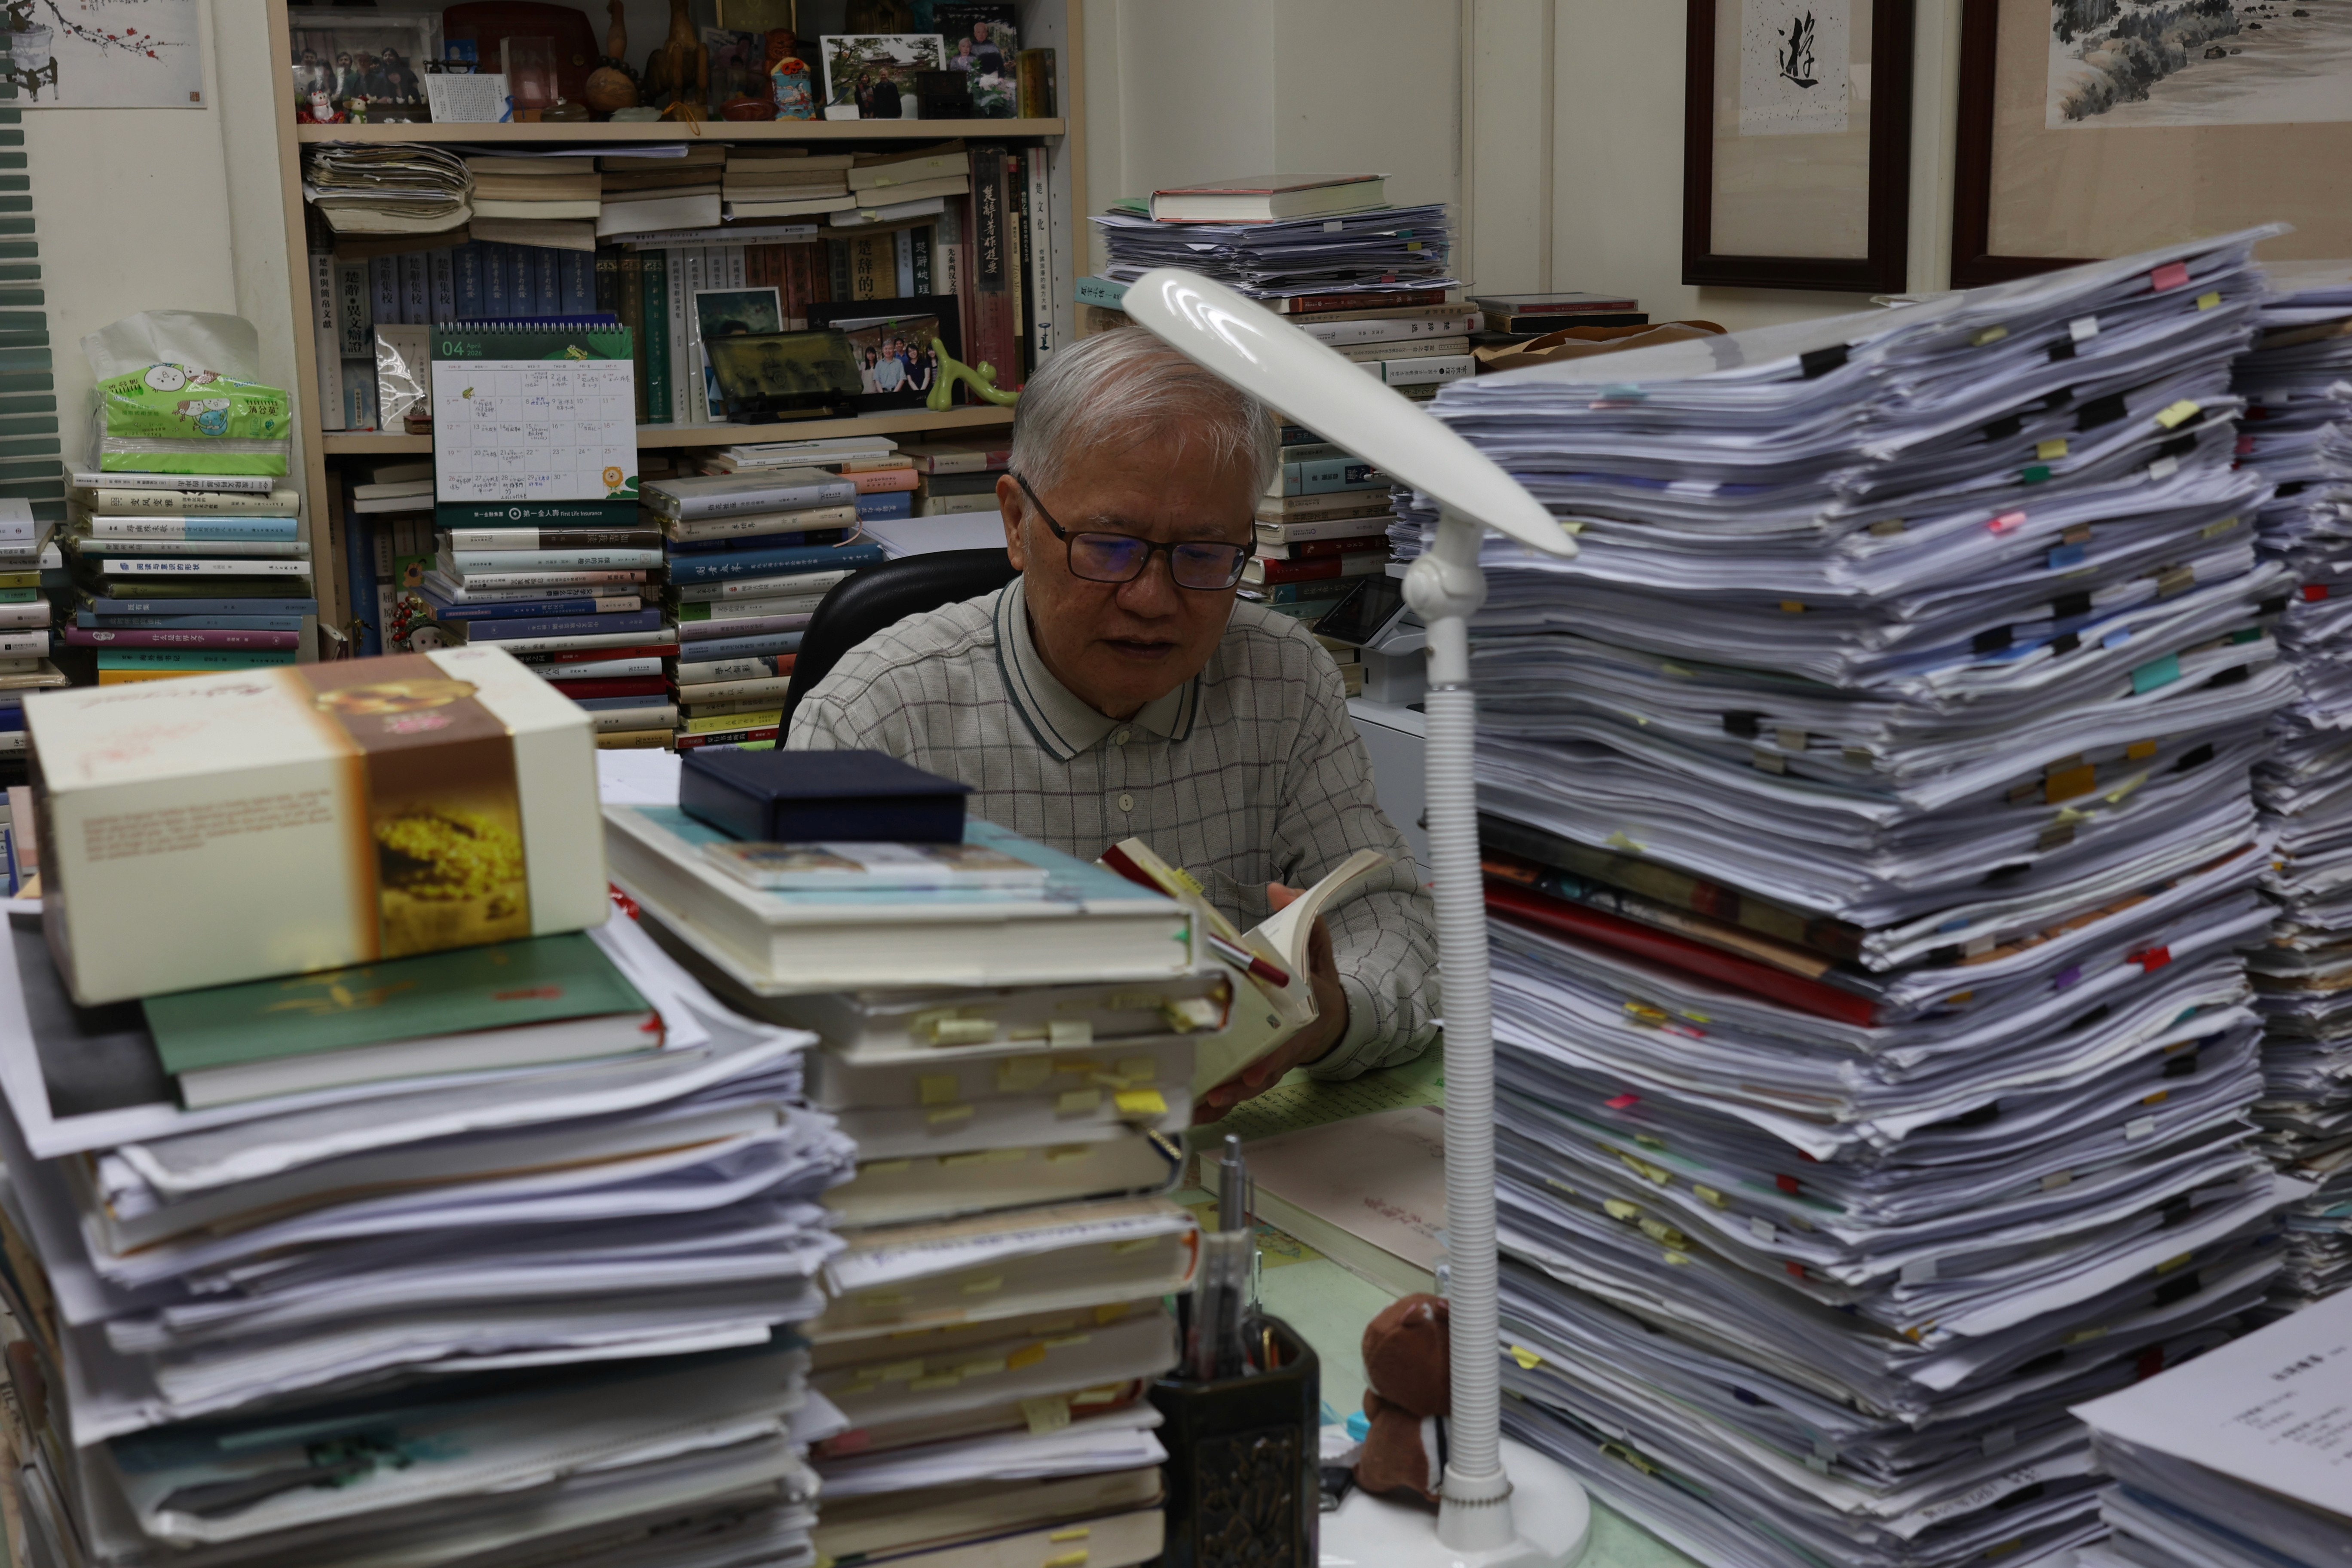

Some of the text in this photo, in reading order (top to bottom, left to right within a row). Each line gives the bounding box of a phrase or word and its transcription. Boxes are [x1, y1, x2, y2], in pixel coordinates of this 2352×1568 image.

[1035, 183, 1045, 231] 楚文化
[916, 241, 930, 295] 楚辭地理
[1411, 321, 1450, 334] 楚辞选
[442, 341, 465, 356] 04
[248, 405, 279, 416] 蒲公英
[130, 498, 174, 507] 变风变雅
[707, 501, 737, 511] 指花扯蕊
[523, 509, 560, 518] 第一金人壽
[587, 533, 629, 544] 如是我读
[546, 588, 593, 597] 文学为什么重要
